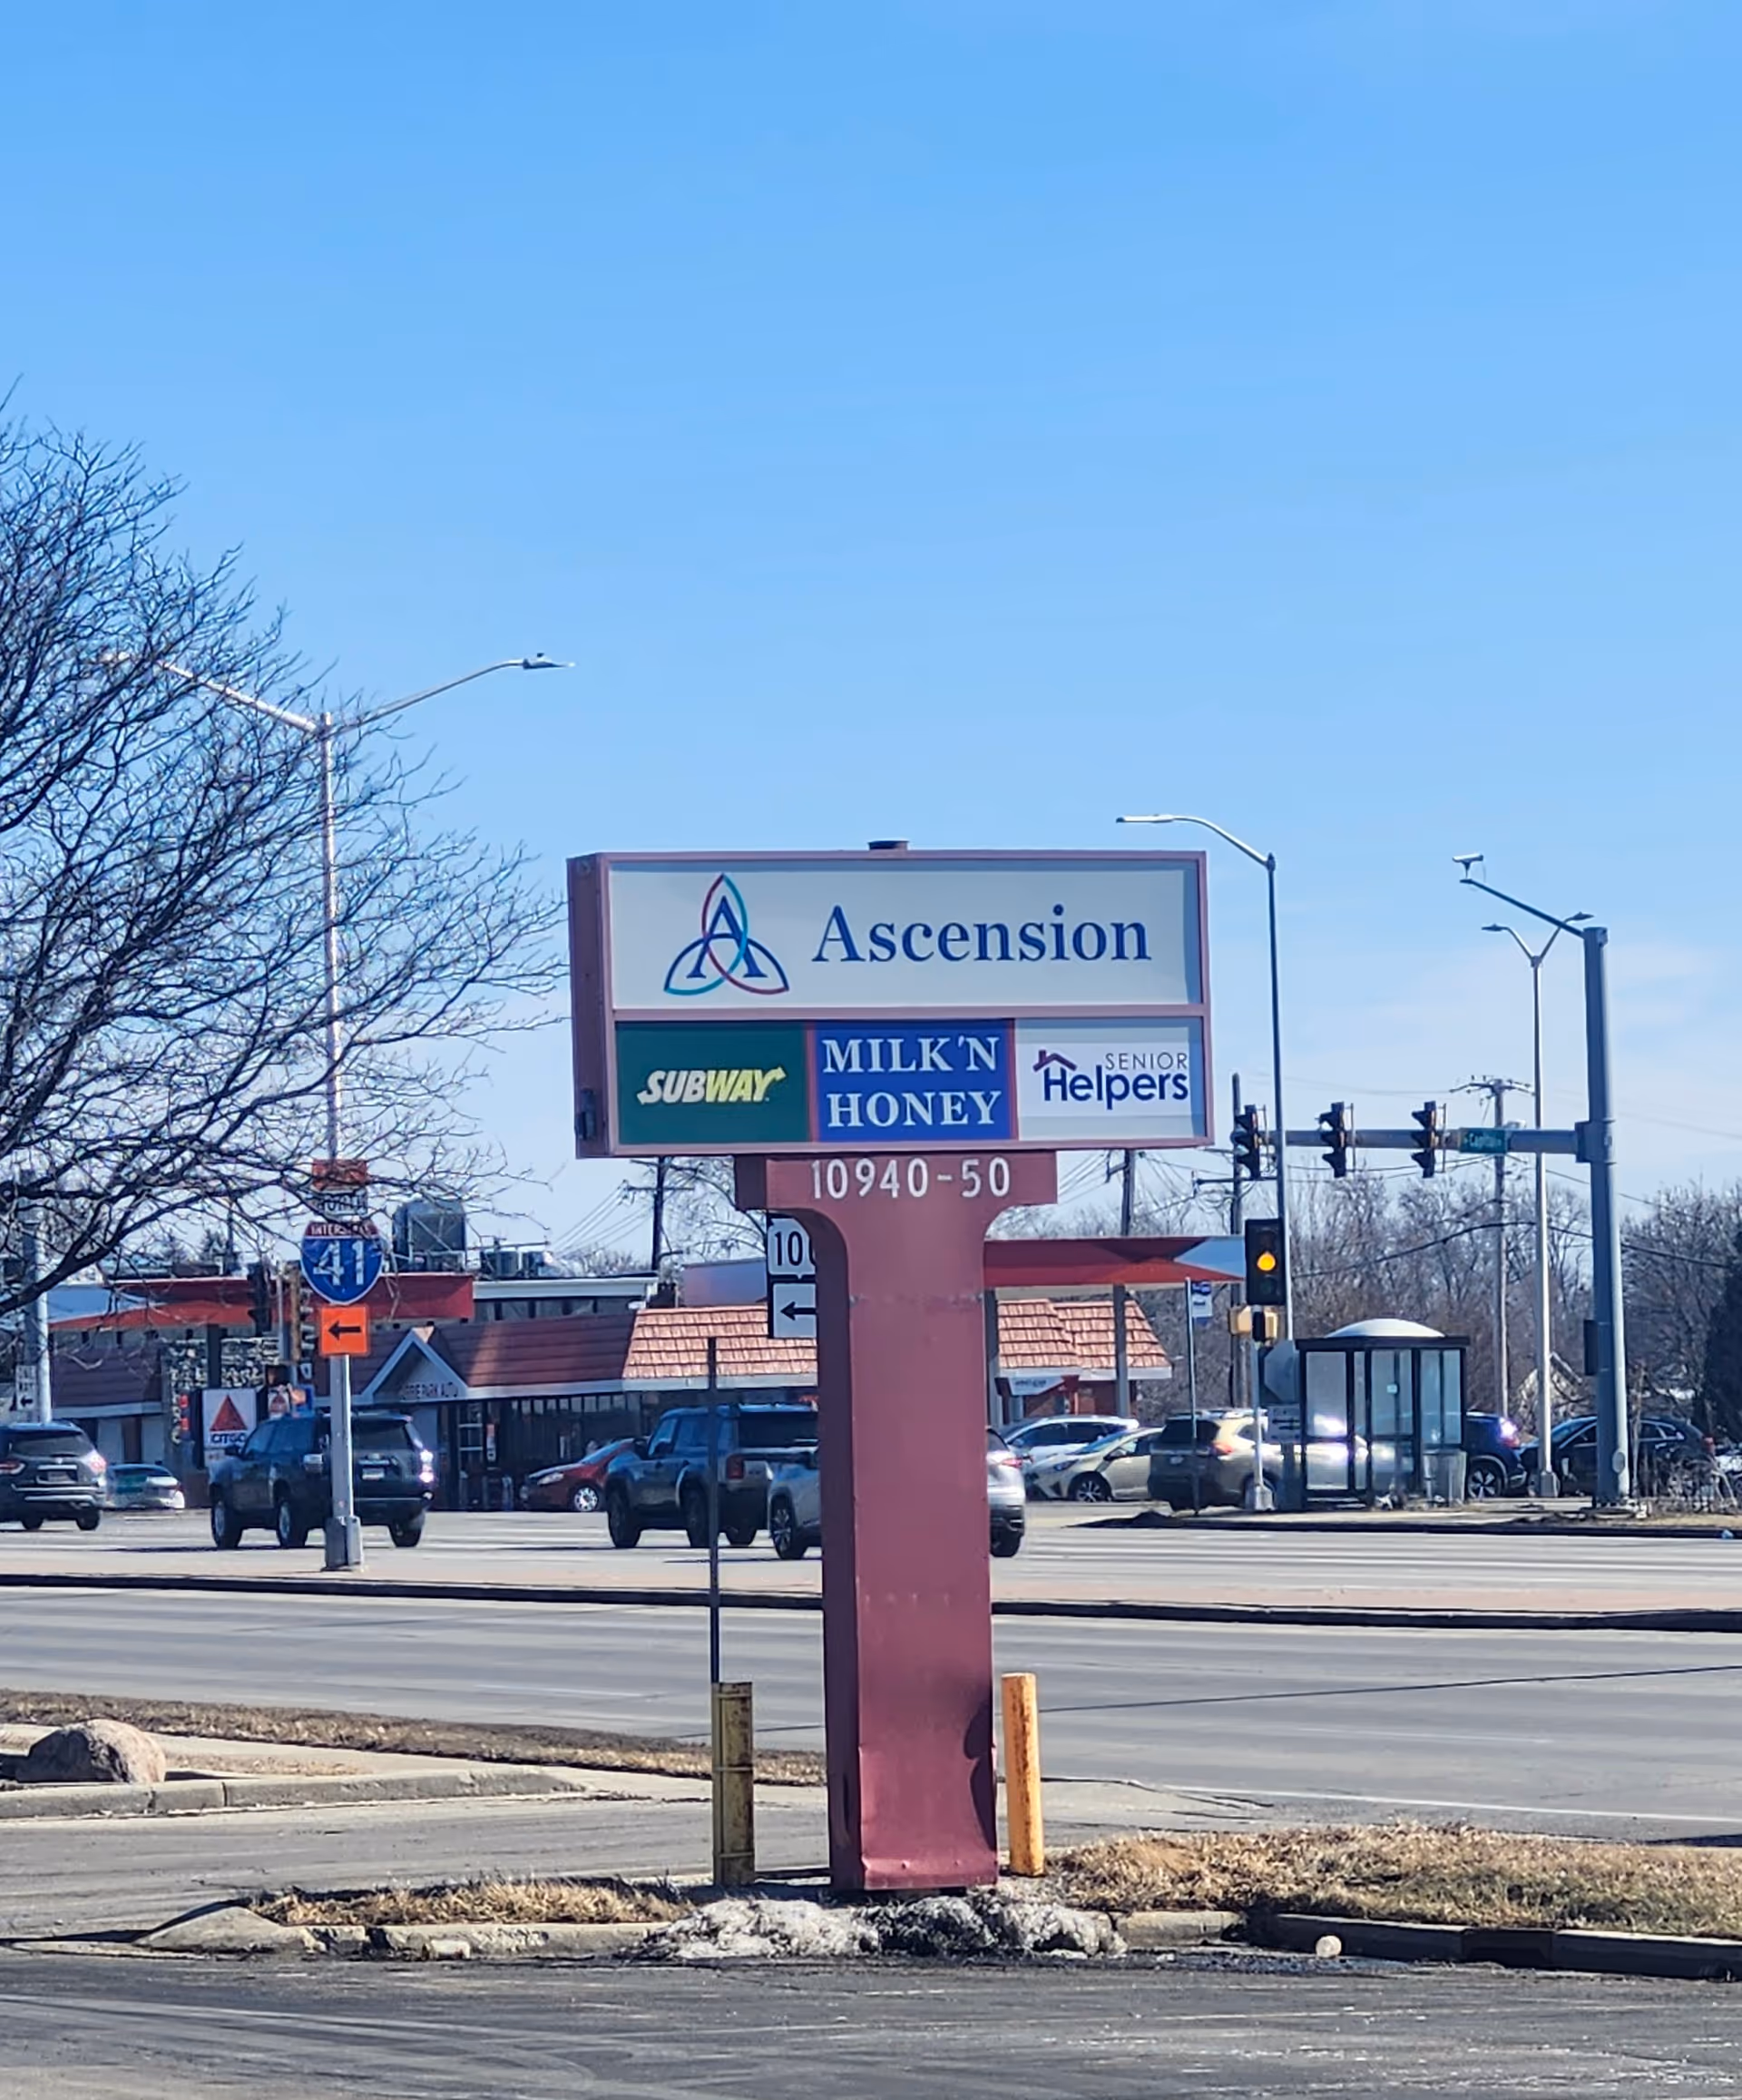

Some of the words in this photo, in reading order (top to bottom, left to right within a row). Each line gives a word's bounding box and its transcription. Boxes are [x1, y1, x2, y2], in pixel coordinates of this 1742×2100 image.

[810, 904, 1152, 962] Ascension
[1105, 1052, 1188, 1071] SENIOR
[637, 1066, 787, 1104] SUBWAY
[1043, 1065, 1189, 1111] Helpers
[827, 1091, 1002, 1127] HONEY
[811, 1157, 1010, 1199] 10940-50
[310, 1222, 375, 1235] INTERS
[313, 1240, 364, 1286] 41
